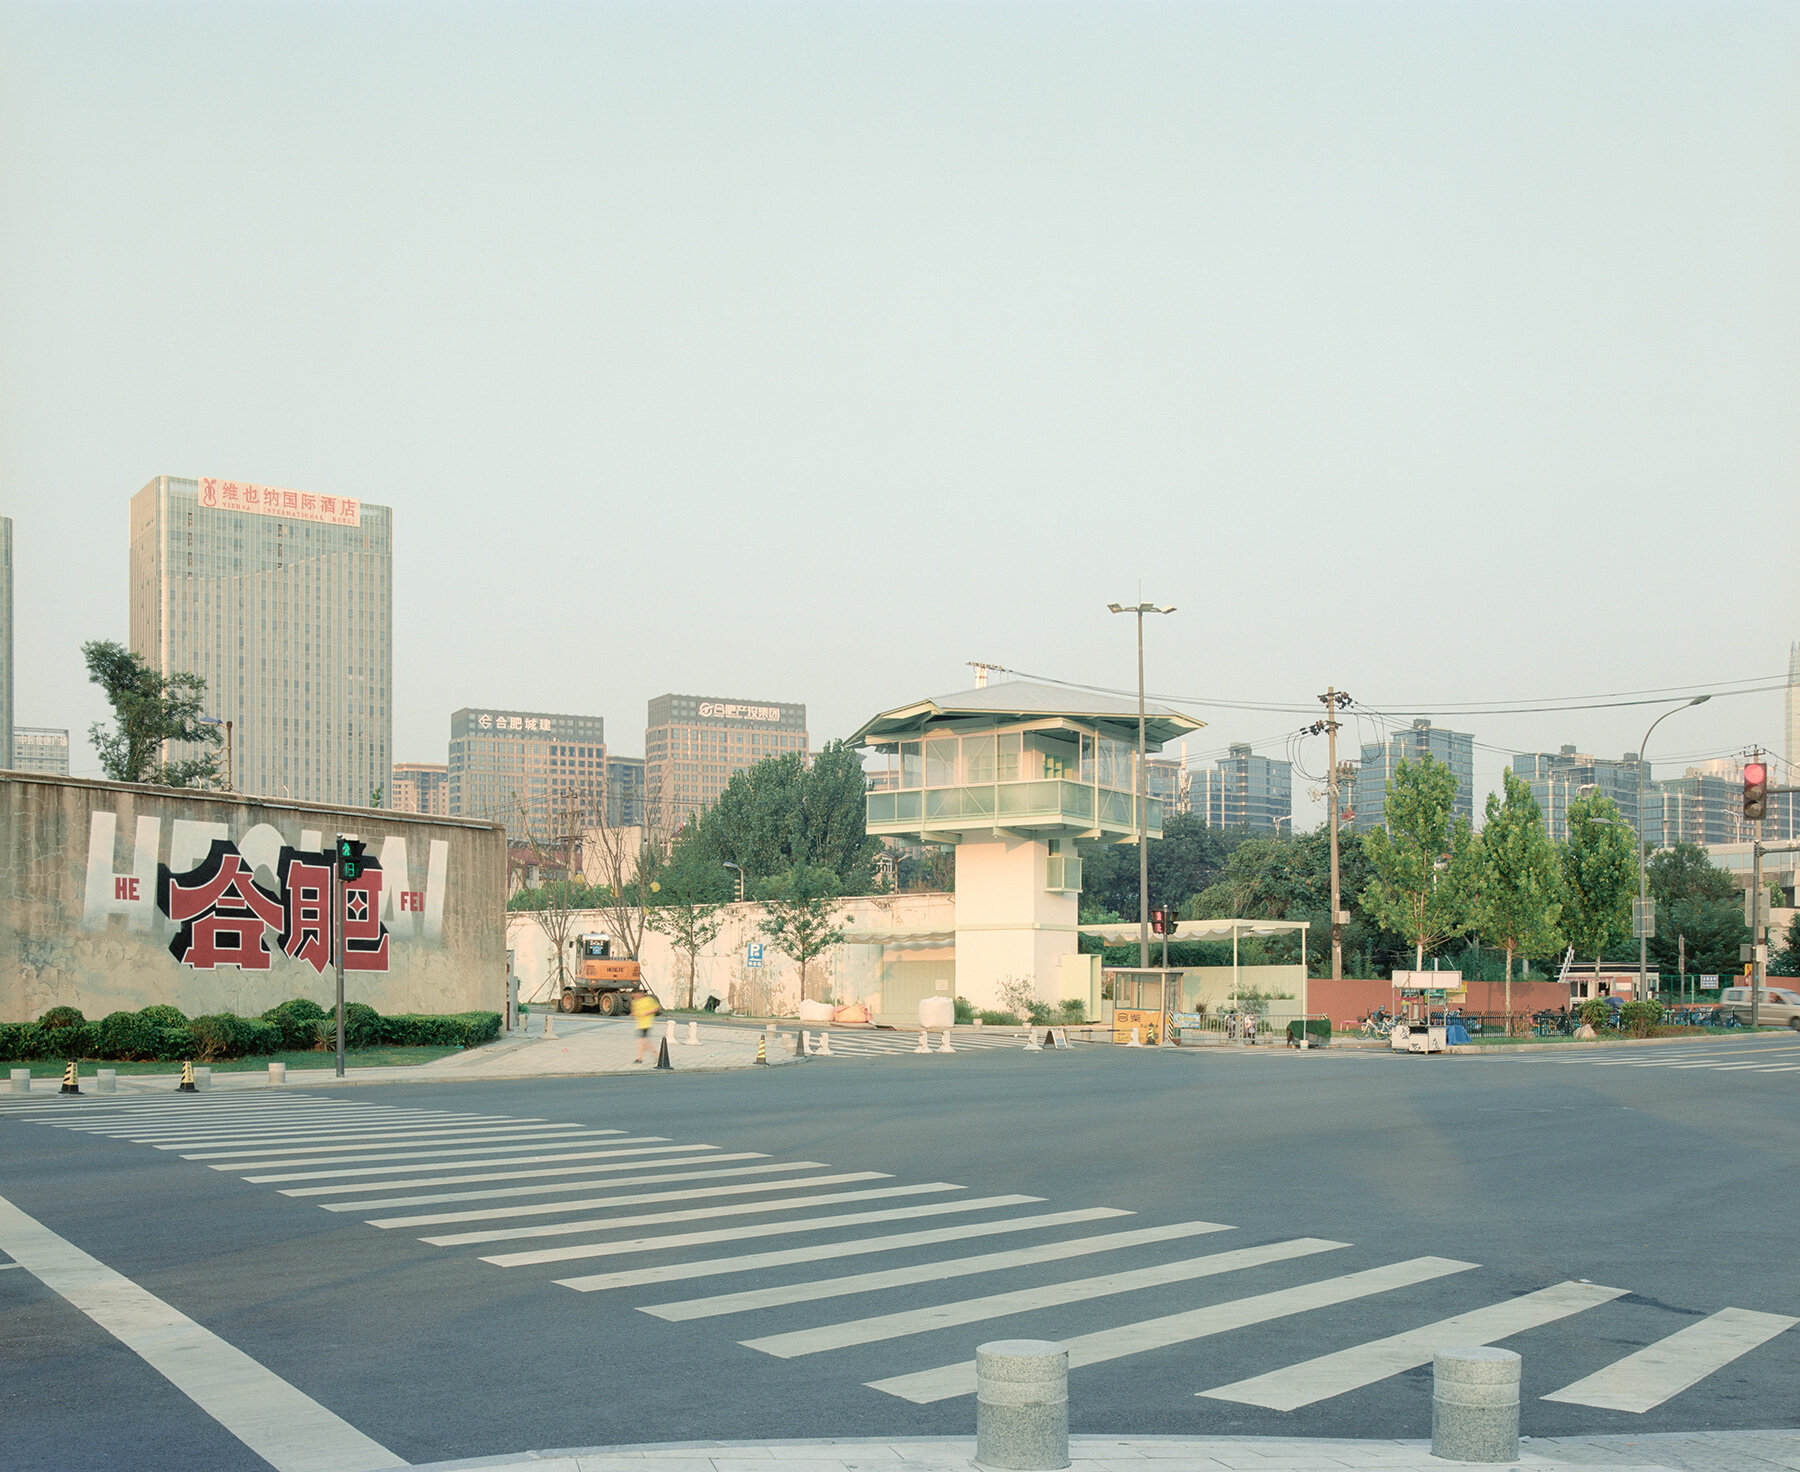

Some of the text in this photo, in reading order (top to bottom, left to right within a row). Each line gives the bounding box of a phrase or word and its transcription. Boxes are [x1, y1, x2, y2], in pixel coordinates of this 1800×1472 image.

[222, 482, 356, 517] 维也纳国际酒店
[495, 715, 552, 731] 合肥城建
[114, 877, 424, 912] HE FEI
[165, 846, 390, 974] 合肥
